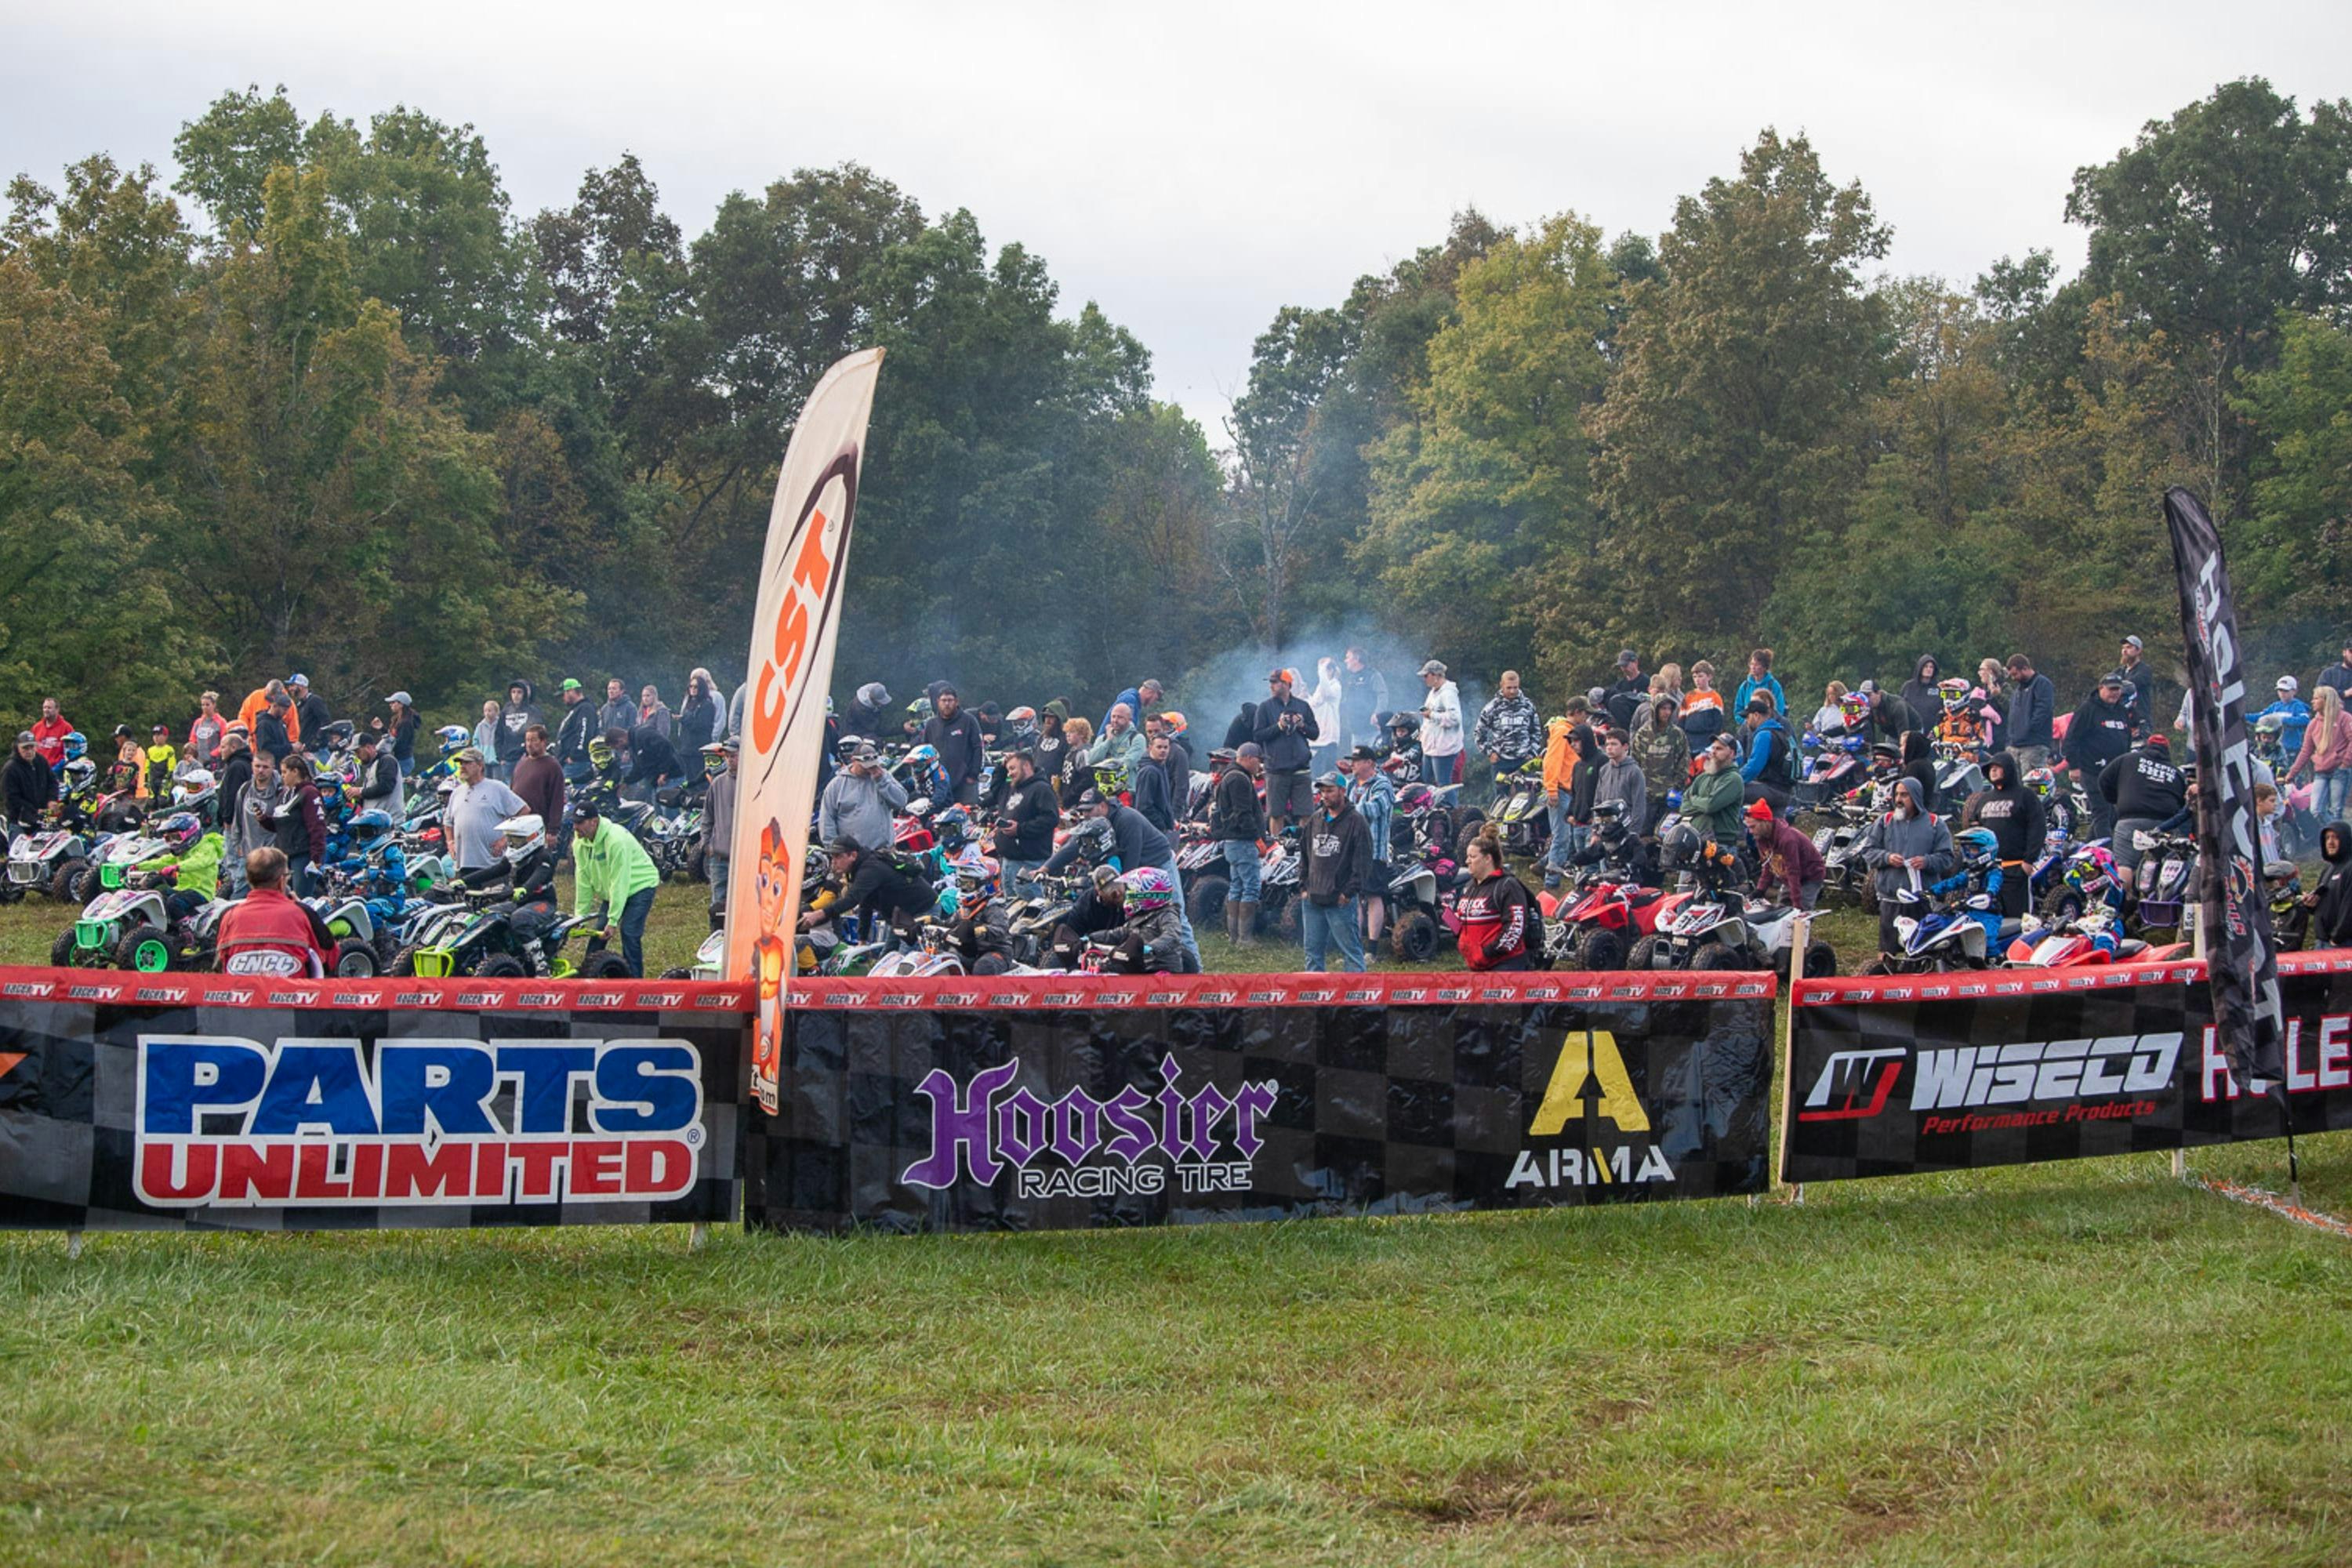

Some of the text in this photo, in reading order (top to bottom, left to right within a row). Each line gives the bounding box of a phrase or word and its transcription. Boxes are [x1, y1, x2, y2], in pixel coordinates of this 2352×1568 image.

[753, 509, 830, 754] CST
[230, 954, 296, 972] GNCC
[141, 1039, 699, 1136] PARTS
[2202, 1013, 2352, 1102] HLE
[902, 1051, 1277, 1189] Hoosier
[1922, 1100, 2156, 1134] Performance Products
[136, 1137, 696, 1202] UNLIMITED
[1019, 1162, 1253, 1198] RACING TIRE
[1504, 1145, 1675, 1189] ARMA
